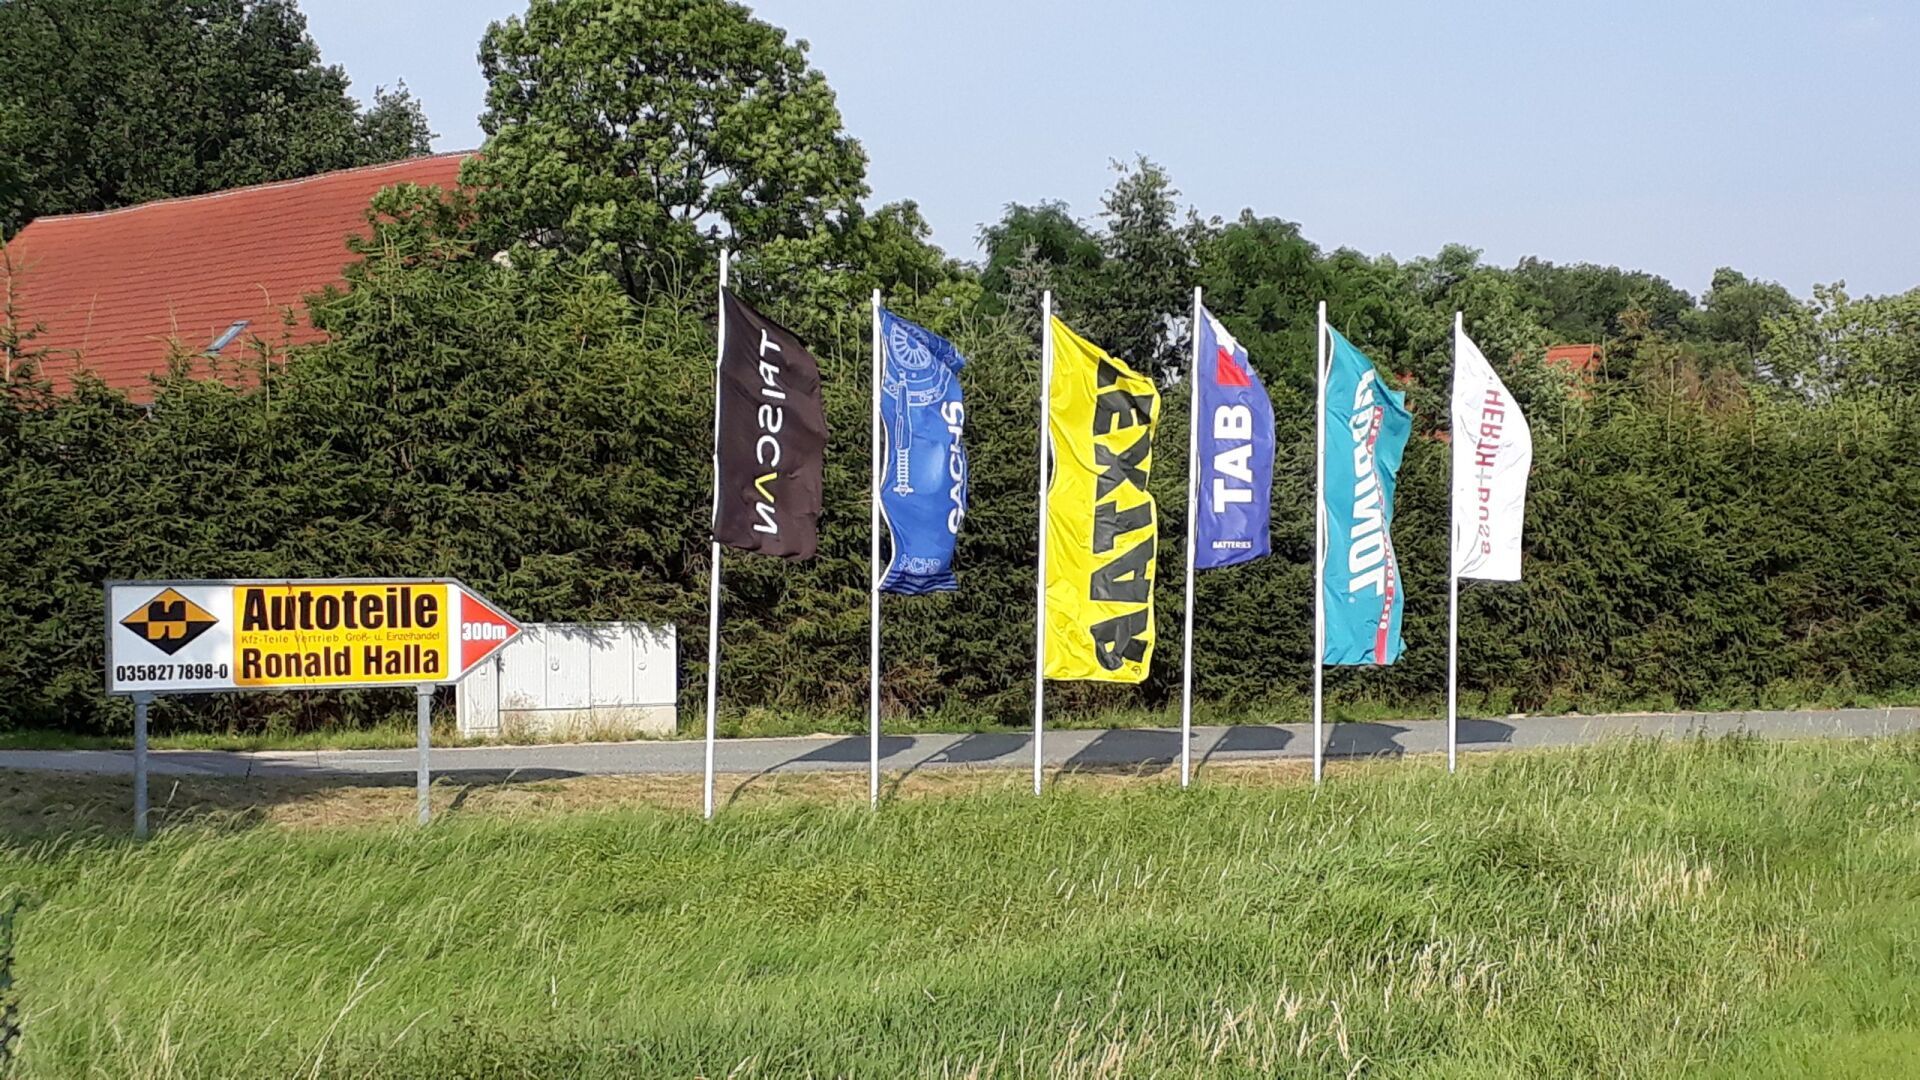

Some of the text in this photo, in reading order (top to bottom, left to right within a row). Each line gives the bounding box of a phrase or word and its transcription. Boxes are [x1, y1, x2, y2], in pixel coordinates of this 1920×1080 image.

[940, 401, 964, 535] SACHS
[1212, 404, 1253, 513] TAB
[1212, 540, 1252, 550] BATTERIES
[242, 587, 439, 631] Autoteile
[241, 634, 289, 644] Kfz-Teile
[295, 633, 340, 644] Vertrieb
[386, 632, 440, 642] Einzelhandel
[462, 622, 508, 641] 300m
[116, 663, 229, 682] 035827 7898-0
[242, 645, 440, 679] Ronald Halla
